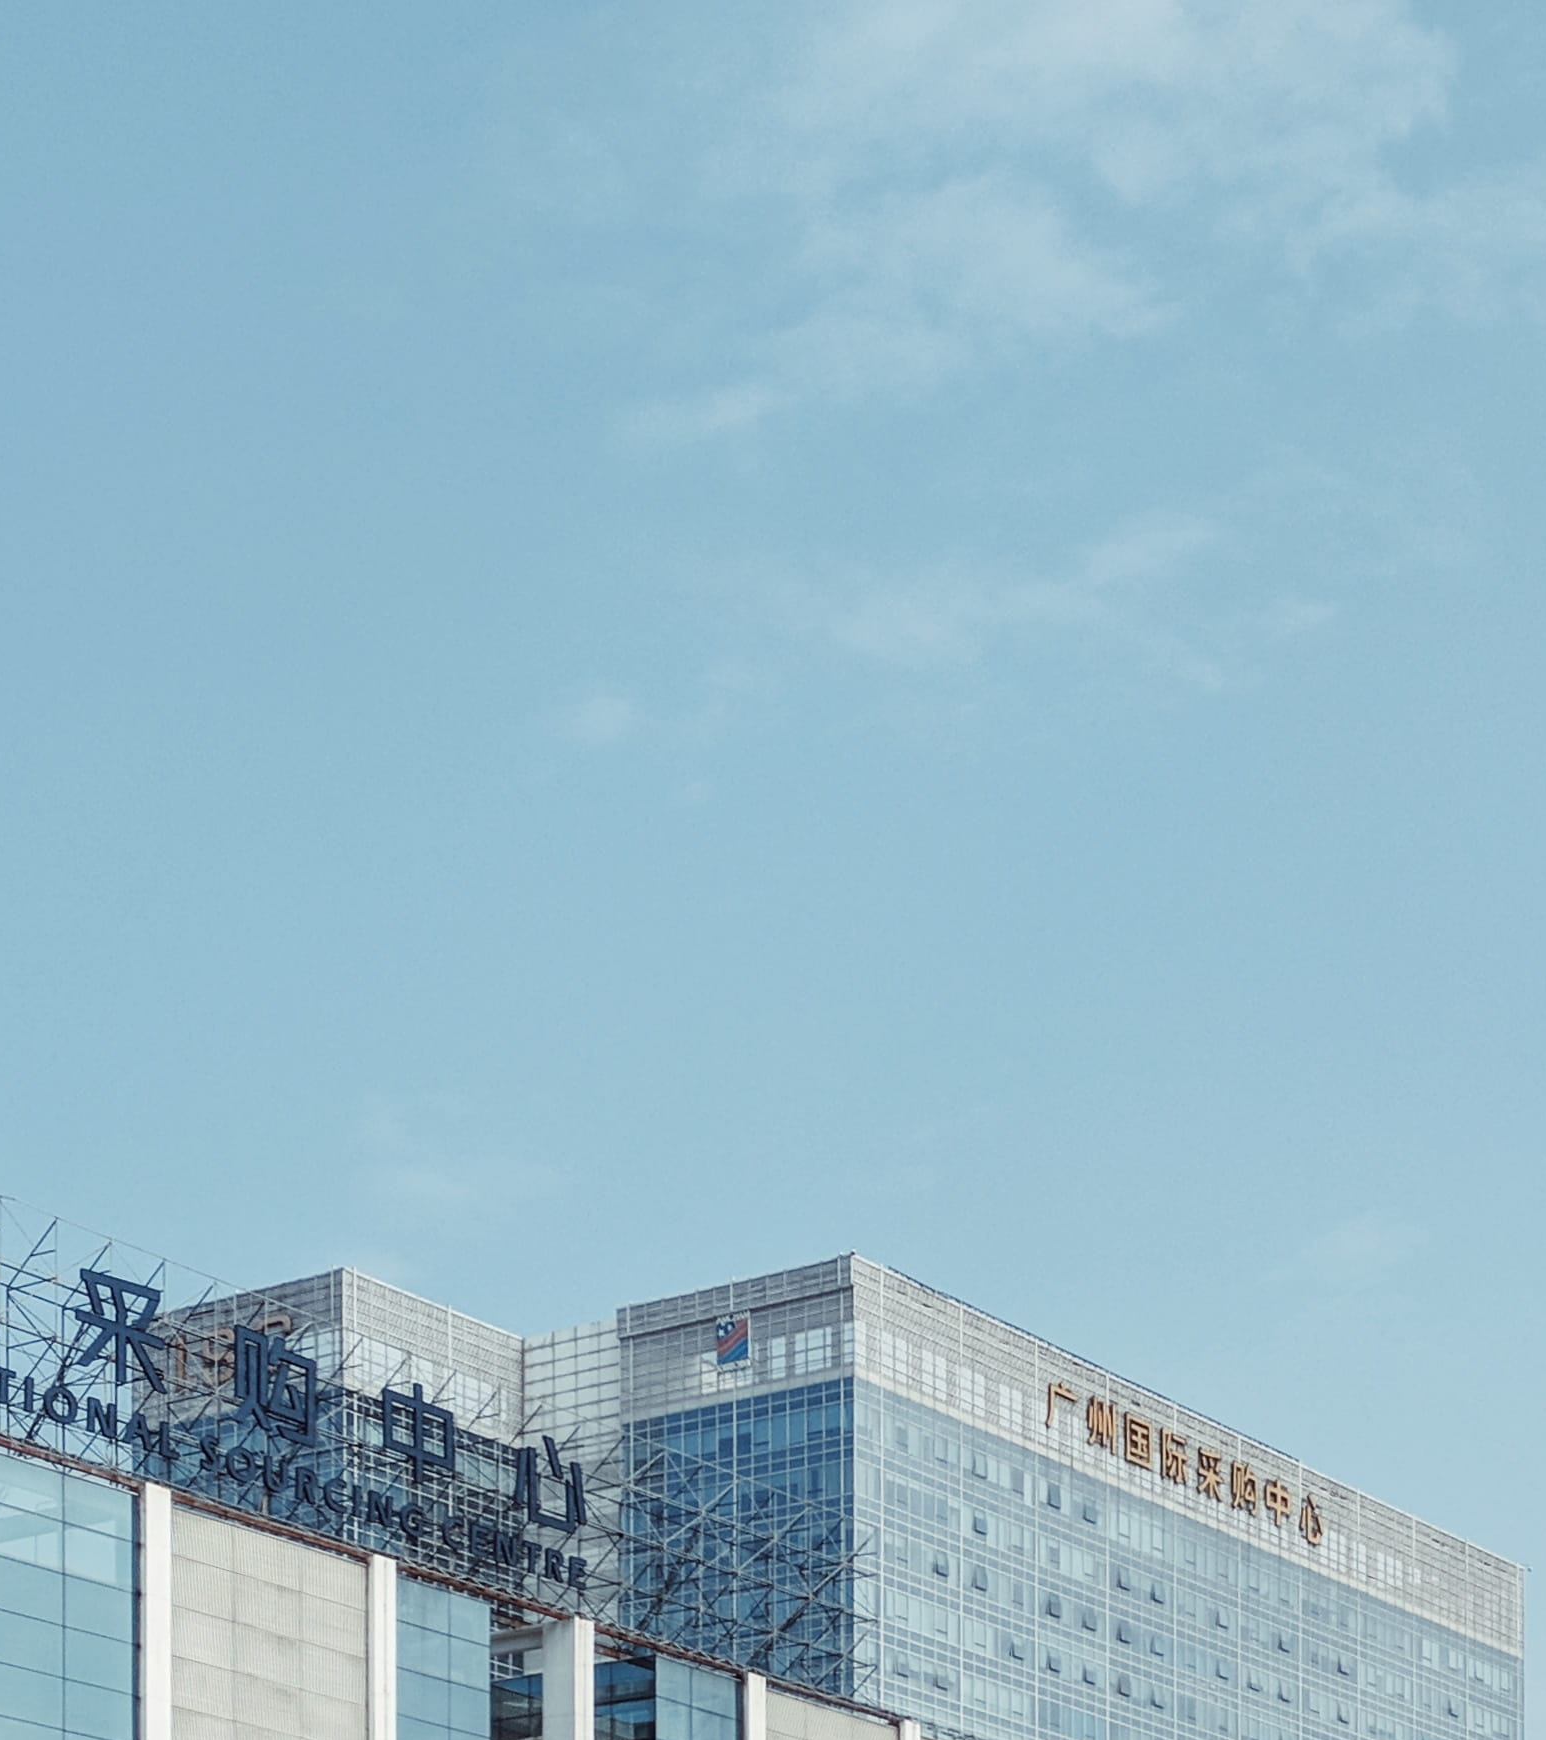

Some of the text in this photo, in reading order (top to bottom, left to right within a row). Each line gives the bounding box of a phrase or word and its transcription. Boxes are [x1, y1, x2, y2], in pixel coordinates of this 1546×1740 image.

[198, 1433, 426, 1537] SOURCING
[443, 1516, 588, 1590] CENTRE
[1045, 1381, 1324, 1546] 广州国际采购中心
